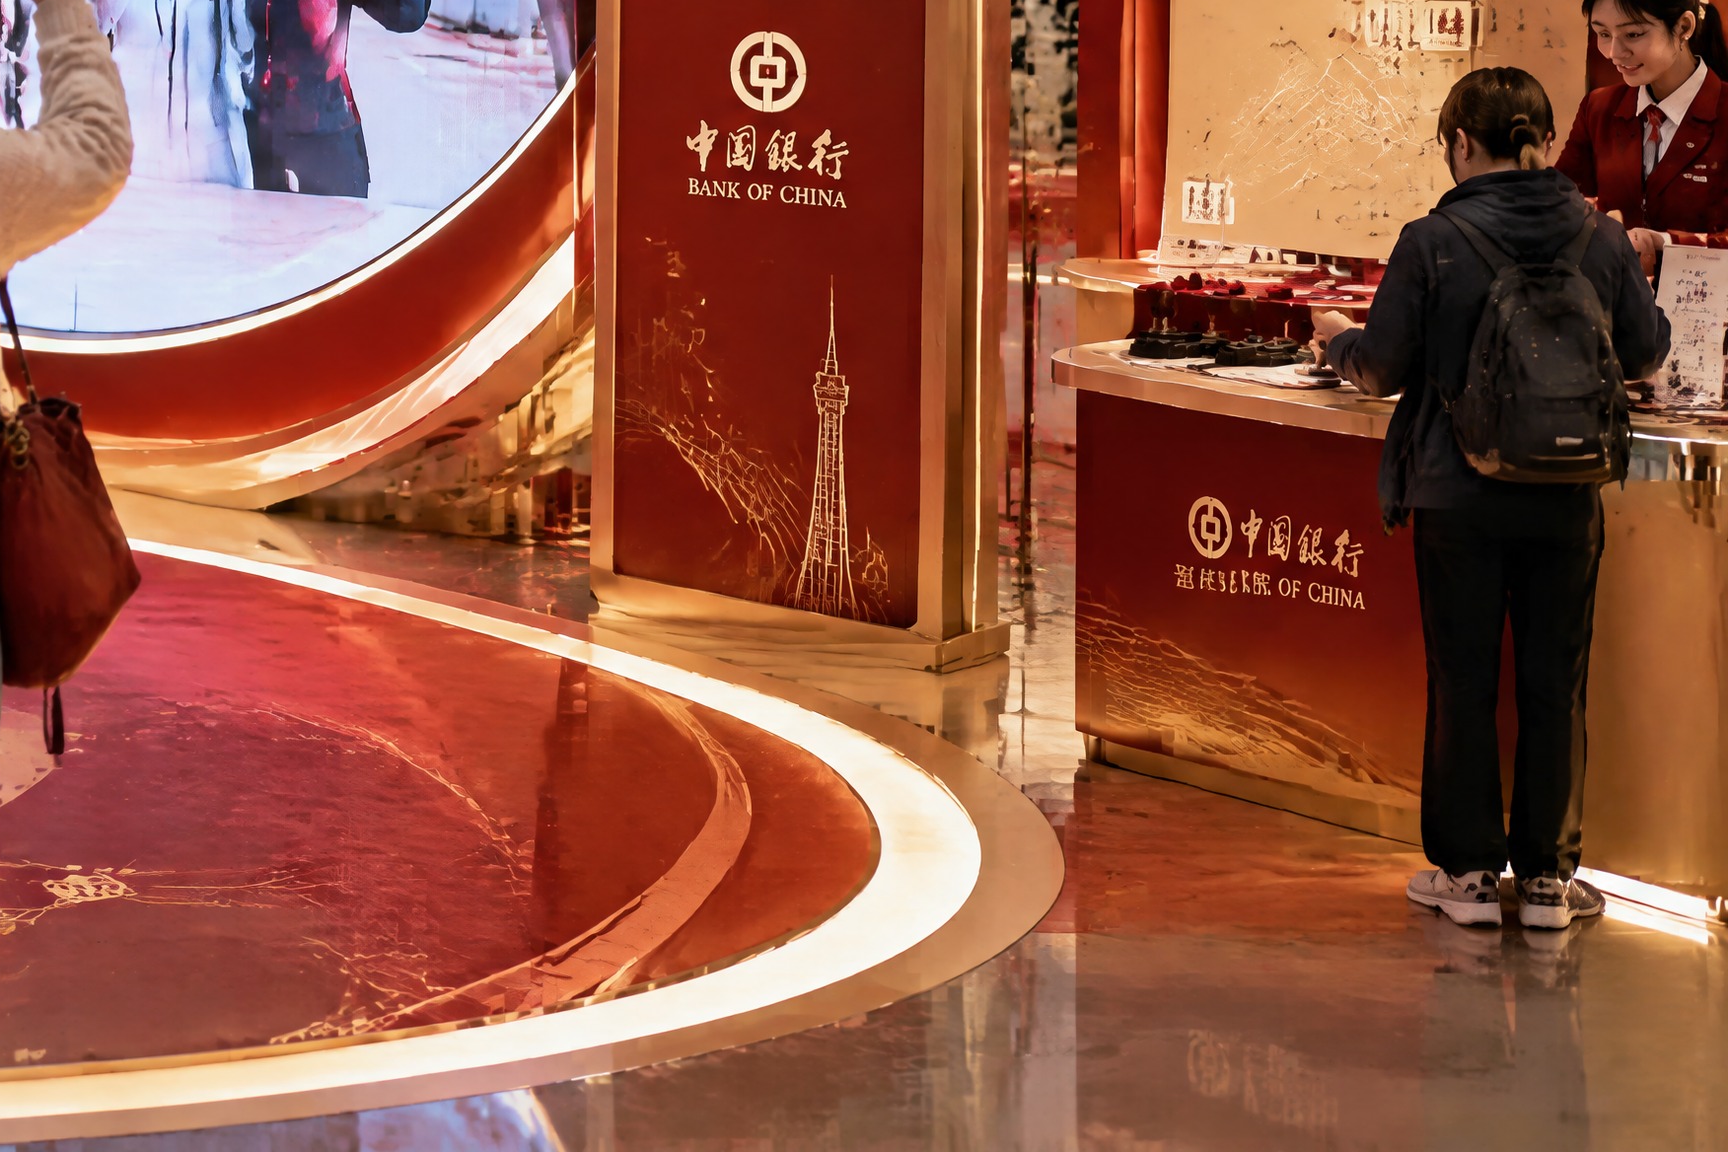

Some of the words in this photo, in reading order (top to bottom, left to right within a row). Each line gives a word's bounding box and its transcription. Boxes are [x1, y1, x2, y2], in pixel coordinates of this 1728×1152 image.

[688, 177, 741, 199] BANK
[747, 183, 774, 201] OF
[780, 185, 847, 208] CHINA
[1278, 578, 1301, 598] OF
[1308, 582, 1365, 609] CHINA
